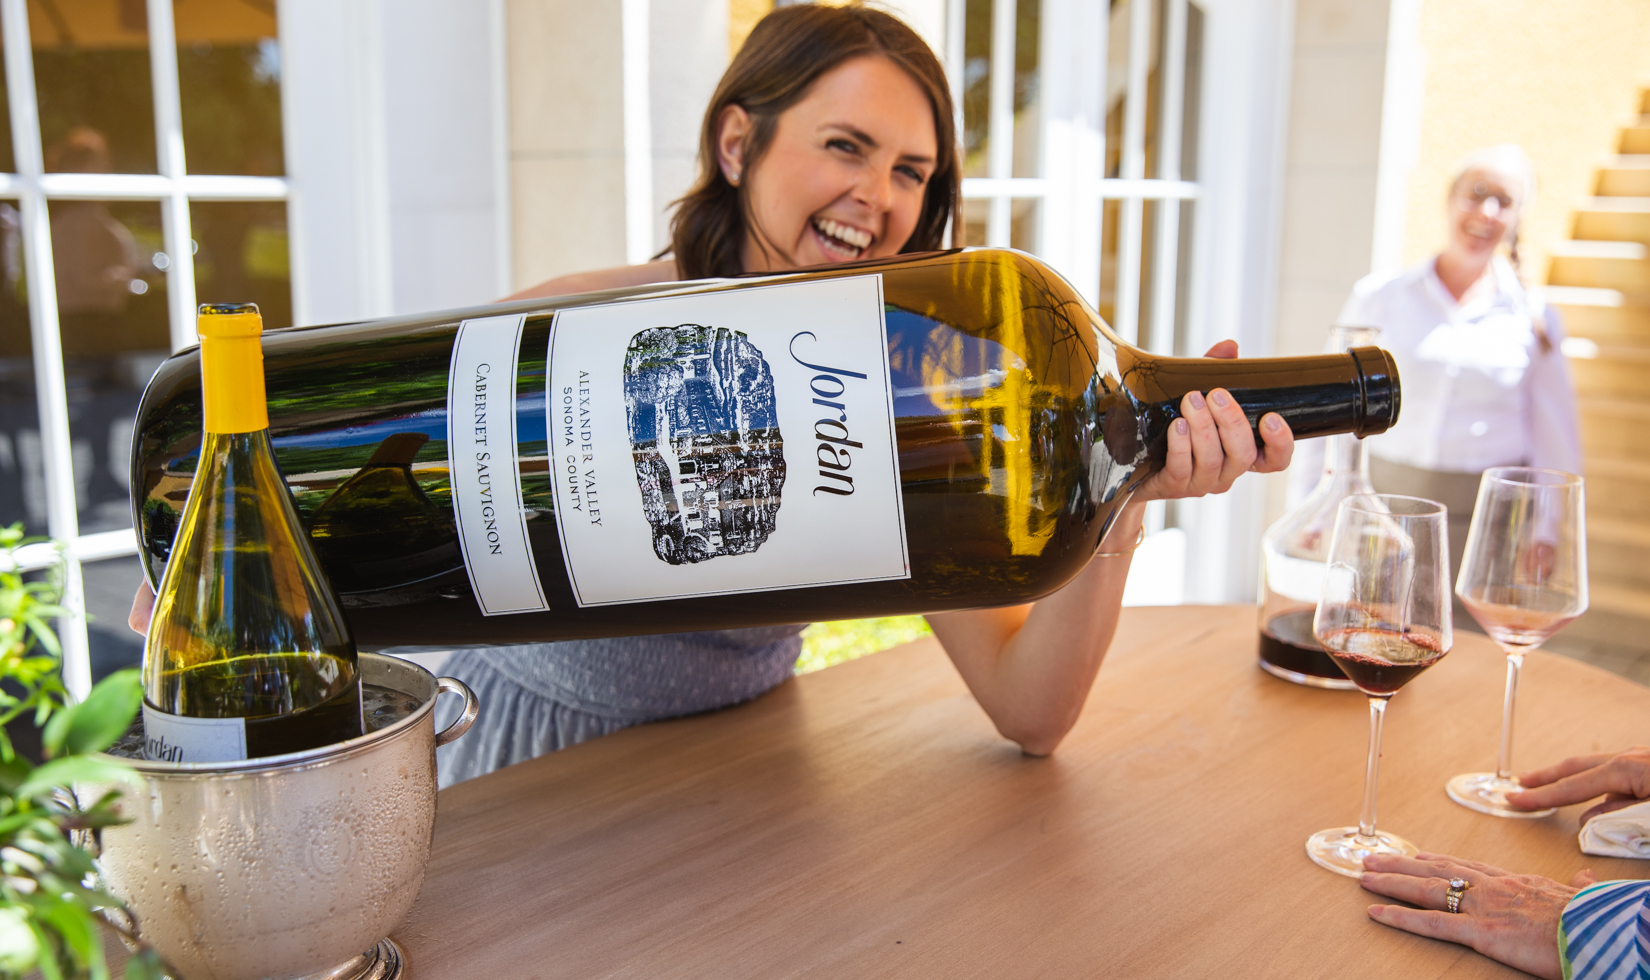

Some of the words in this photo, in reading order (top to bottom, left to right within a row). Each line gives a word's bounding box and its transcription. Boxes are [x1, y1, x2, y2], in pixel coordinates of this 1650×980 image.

[474, 362, 491, 446] CABERNET
[563, 386, 574, 447] SONOMA
[579, 370, 594, 464] ALEXANDER
[788, 330, 868, 497] Jordan
[475, 452, 503, 556] SAUVIGNON
[566, 455, 582, 512] COUNTY
[584, 469, 603, 527] VALLEY
